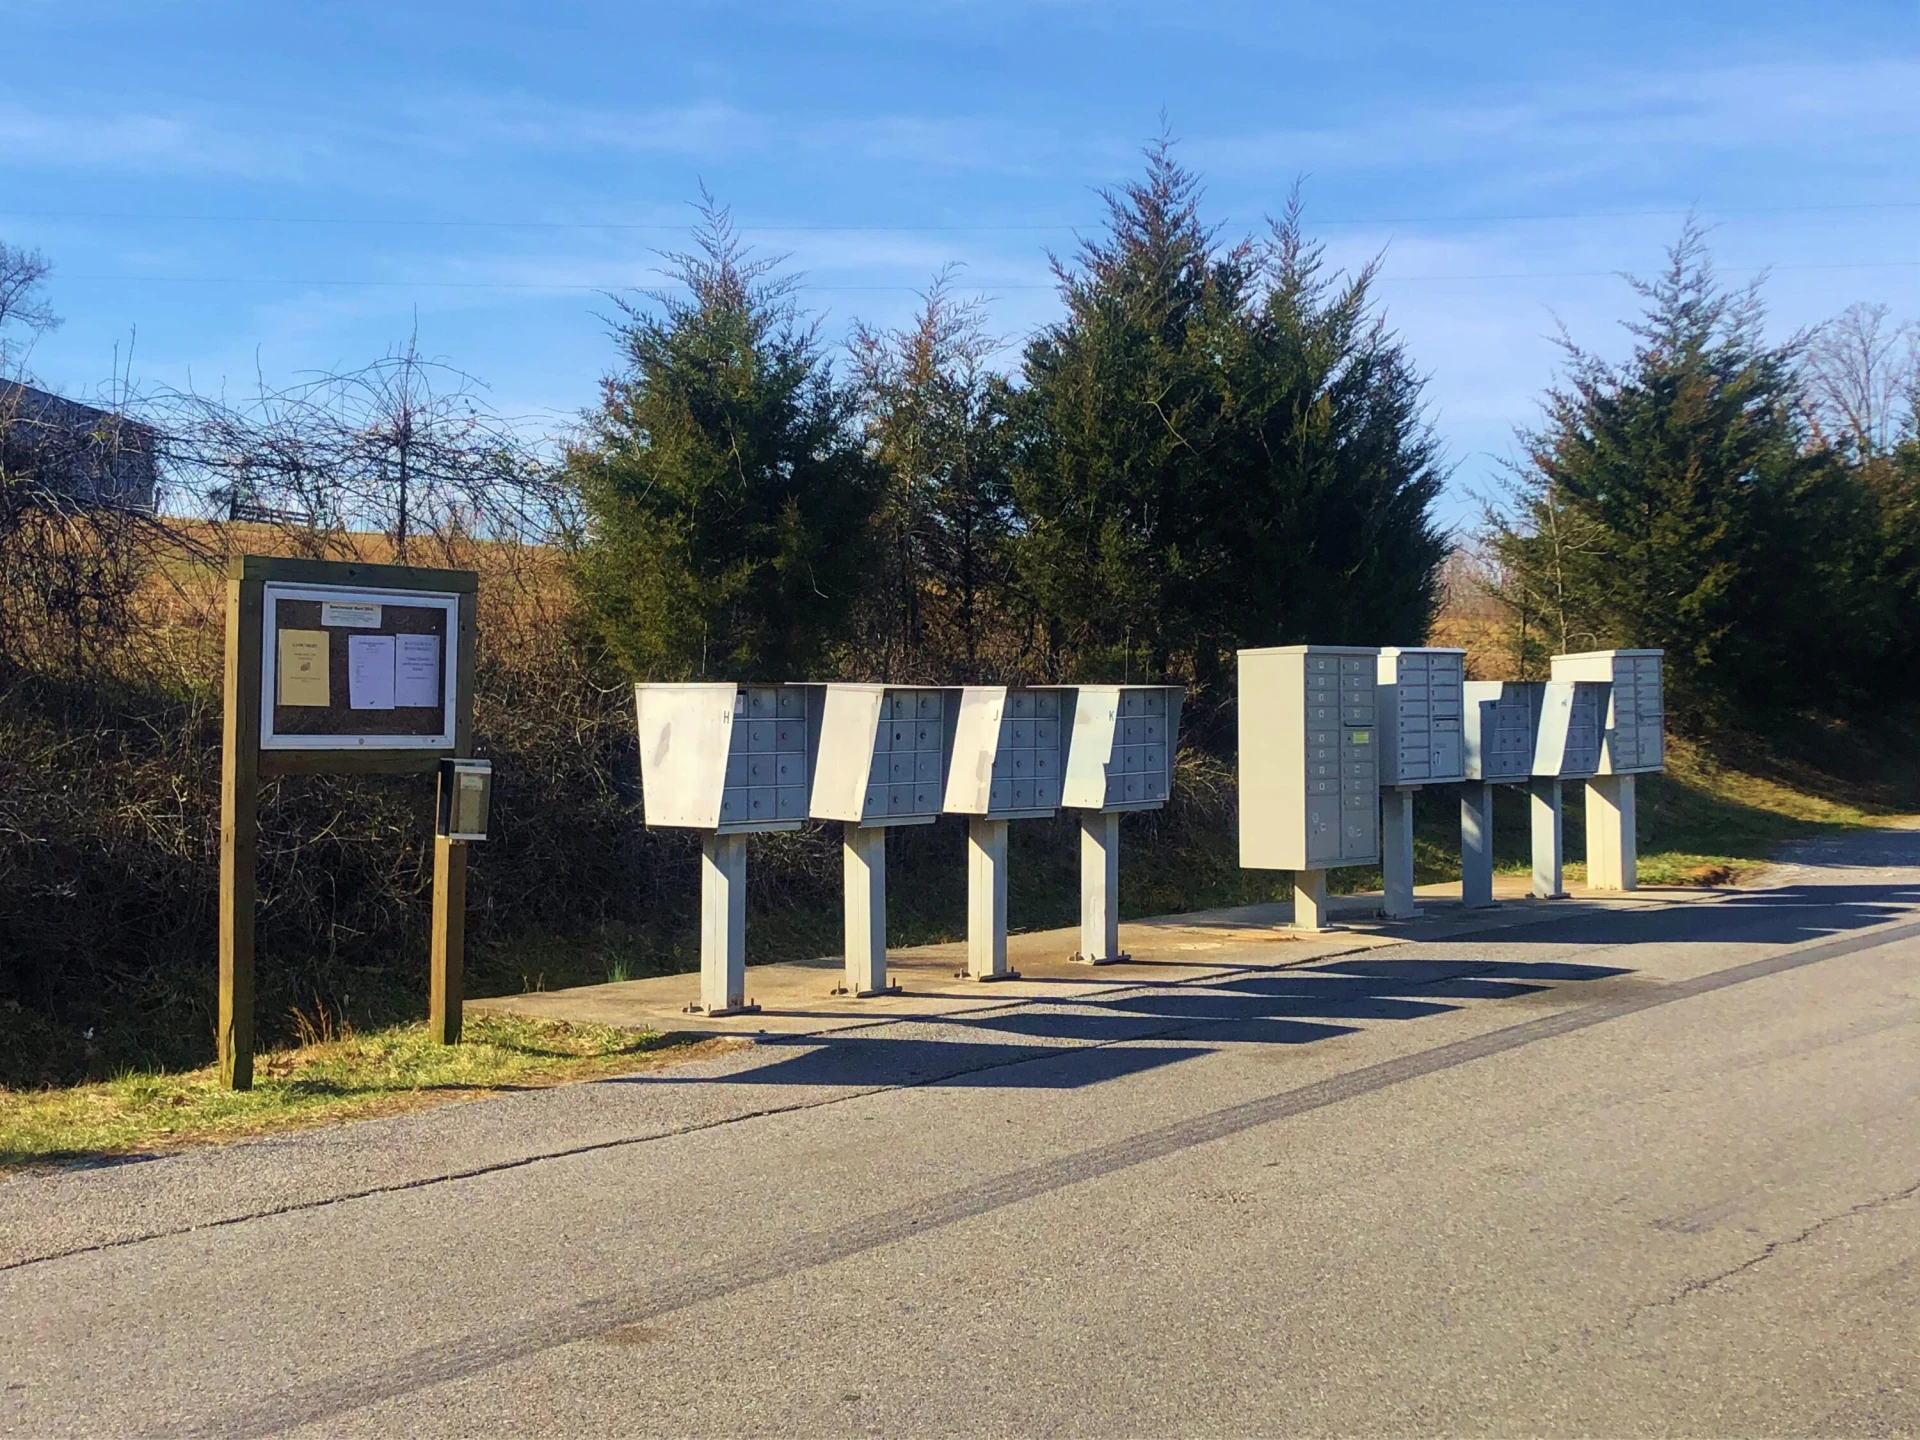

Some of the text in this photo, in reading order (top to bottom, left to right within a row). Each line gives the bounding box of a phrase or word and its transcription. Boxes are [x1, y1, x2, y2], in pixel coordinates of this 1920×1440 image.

[723, 711, 730, 723] H
[993, 709, 998, 721] J
[1108, 710, 1115, 722] K
